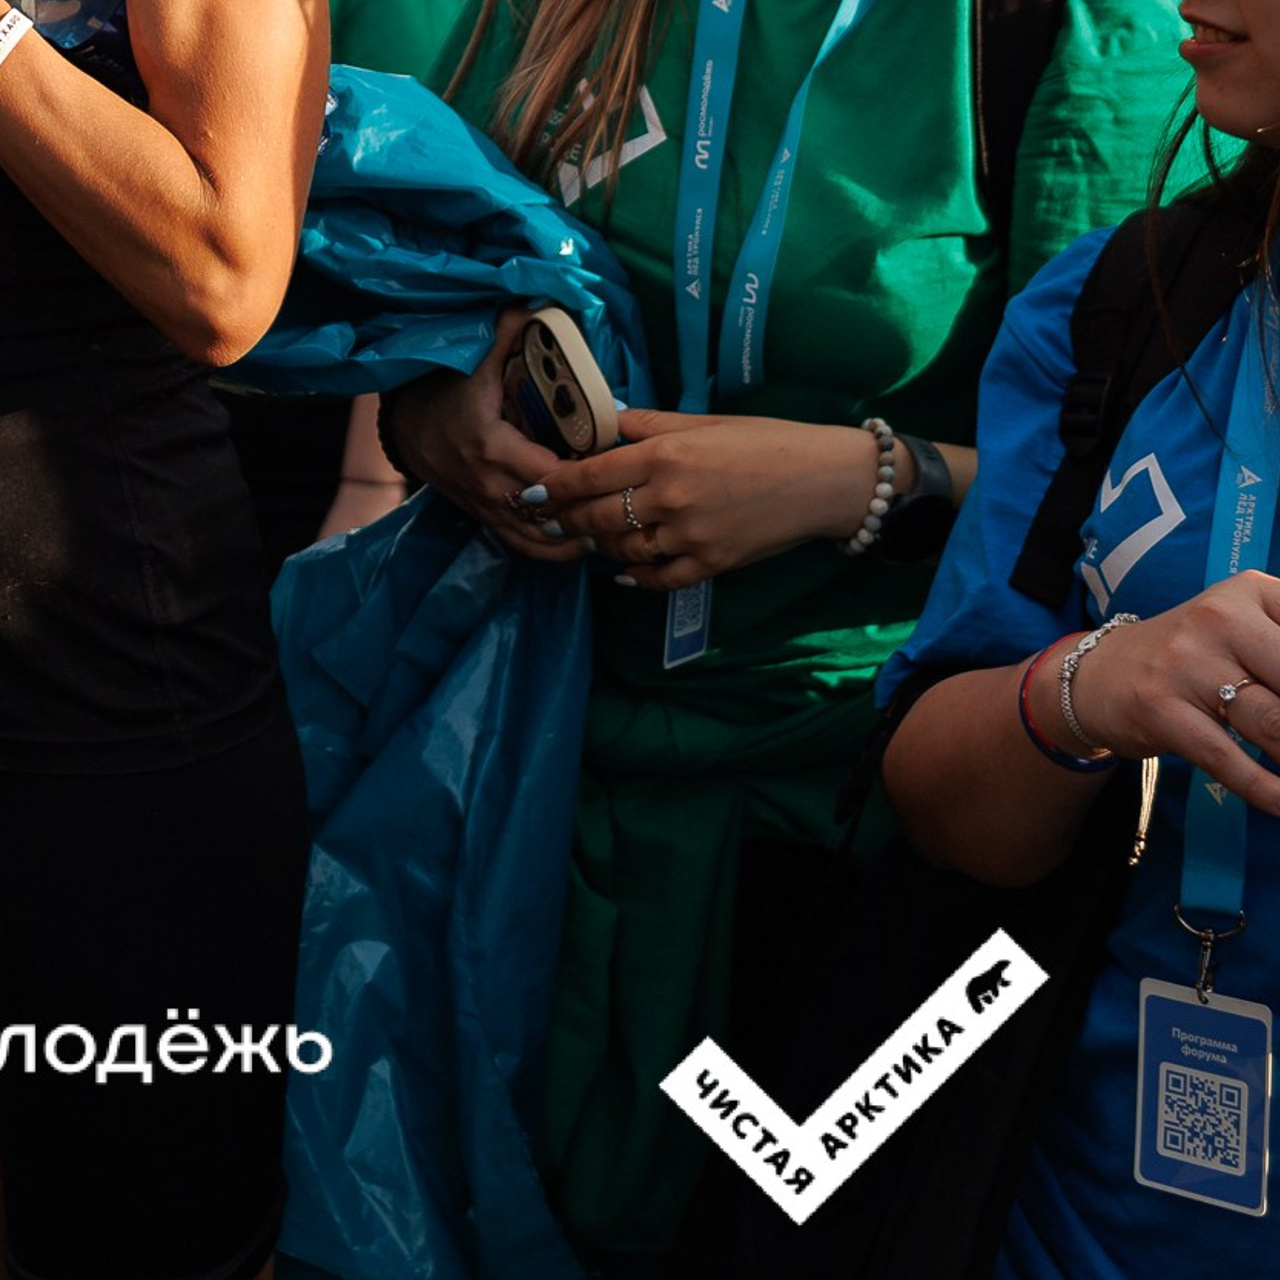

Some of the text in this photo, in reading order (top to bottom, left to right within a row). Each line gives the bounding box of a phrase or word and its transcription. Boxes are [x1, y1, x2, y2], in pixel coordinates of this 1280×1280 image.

[1242, 494, 1256, 543] АРКТИКА
[1228, 517, 1244, 574] ТРОНУЛСЯ
[1172, 1027, 1238, 1053] Программа
[1180, 1043, 1227, 1064] форума
